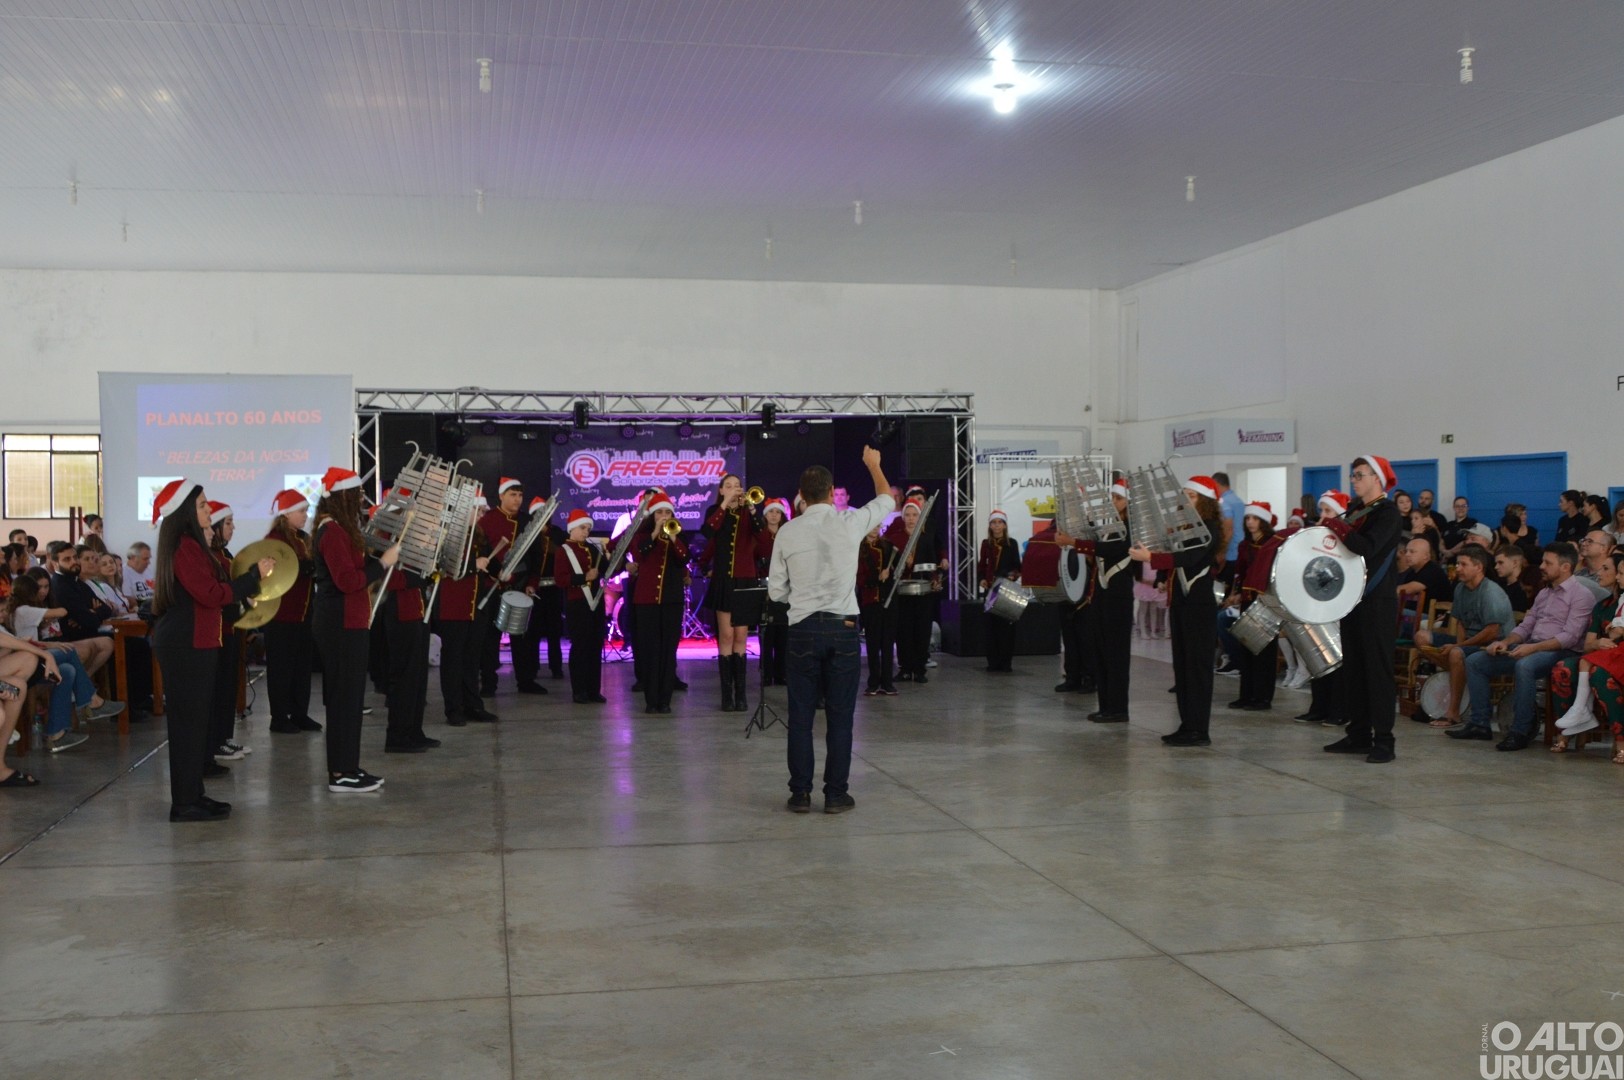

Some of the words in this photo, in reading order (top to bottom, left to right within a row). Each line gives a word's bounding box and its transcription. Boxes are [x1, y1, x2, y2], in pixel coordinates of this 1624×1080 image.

[145, 411, 239, 427] PLANALTO
[243, 411, 267, 425] 60
[271, 409, 323, 425] ANOS
[606, 460, 674, 477] FREE
[672, 460, 725, 477] SOM
